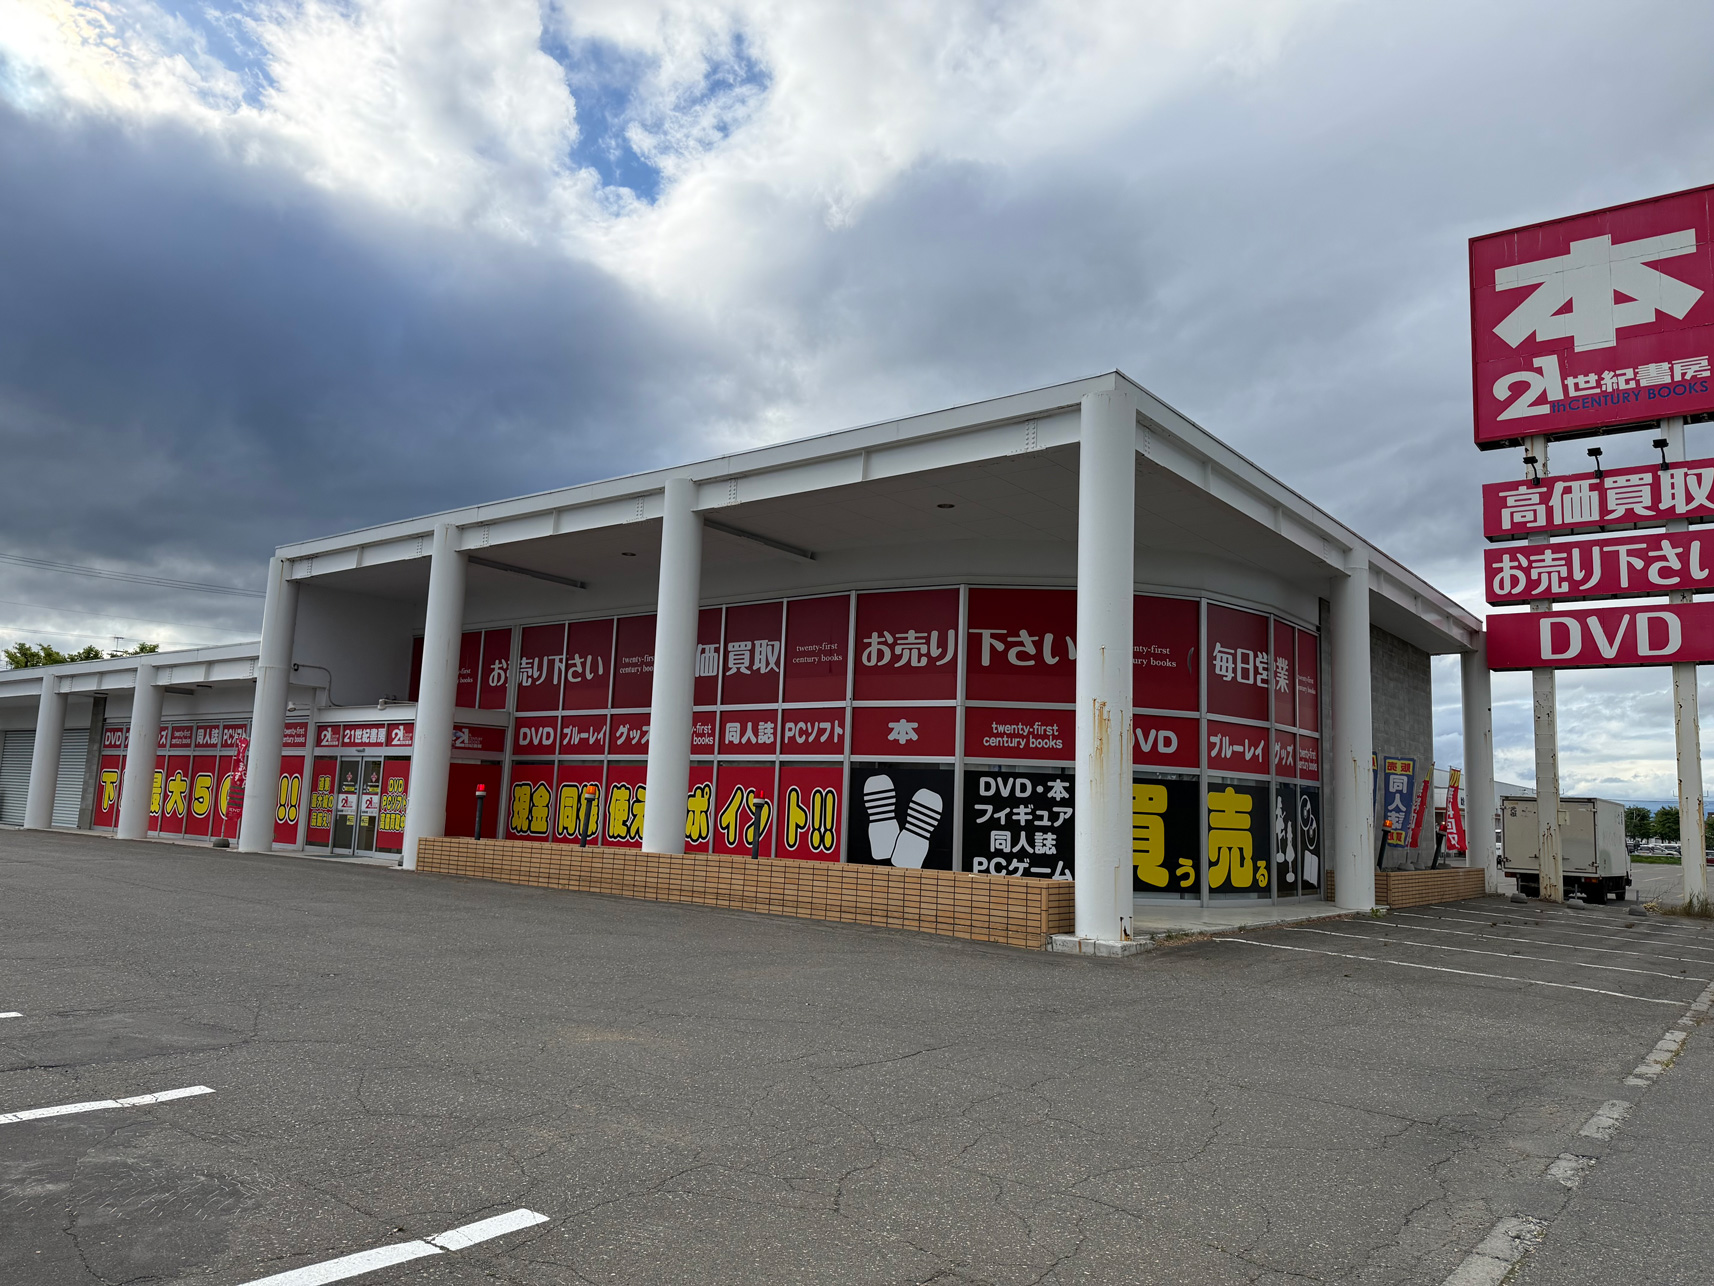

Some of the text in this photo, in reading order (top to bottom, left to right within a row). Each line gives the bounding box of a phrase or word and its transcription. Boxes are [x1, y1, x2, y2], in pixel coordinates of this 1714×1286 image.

[1492, 228, 1705, 353] 本
[1492, 354, 1711, 421] 21世紀書房
[1568, 390, 1641, 411] CENTURY
[1648, 381, 1709, 400] BOOKS
[1499, 468, 1714, 530] 高価買取
[1540, 611, 1682, 660] DVD
[694, 640, 780, 678] 価買取
[793, 653, 843, 664] century books
[796, 642, 838, 653] twenty-first
[862, 629, 1077, 667] お売り下さい
[1133, 645, 1170, 655] nty-first
[619, 664, 654, 675] century boo
[622, 654, 655, 665] twenty-firs
[1150, 657, 1177, 667] books
[1213, 641, 1289, 693] 毎日営業
[105, 732, 122, 746] DVD
[196, 728, 219, 745] 同人誌
[283, 735, 294, 743] entury
[343, 728, 386, 743] 21世紀書房
[519, 727, 555, 745] DVD
[562, 725, 607, 745] ブルーレイ
[693, 733, 714, 744] books
[725, 721, 775, 744] 同人誌
[785, 720, 843, 743] PCソフト
[887, 718, 919, 745] 本
[992, 721, 1059, 736] twenty-first
[983, 734, 1063, 749] century books
[1133, 728, 1179, 754] VD
[1209, 732, 1265, 763] ブルーレイ
[1274, 741, 1294, 767] グッズ
[388, 777, 404, 793] DVD
[979, 777, 1070, 801] DVD・本
[974, 804, 1073, 827] フィギュア
[990, 831, 1057, 854] 同人誌
[973, 857, 1073, 880] PCゲーム
